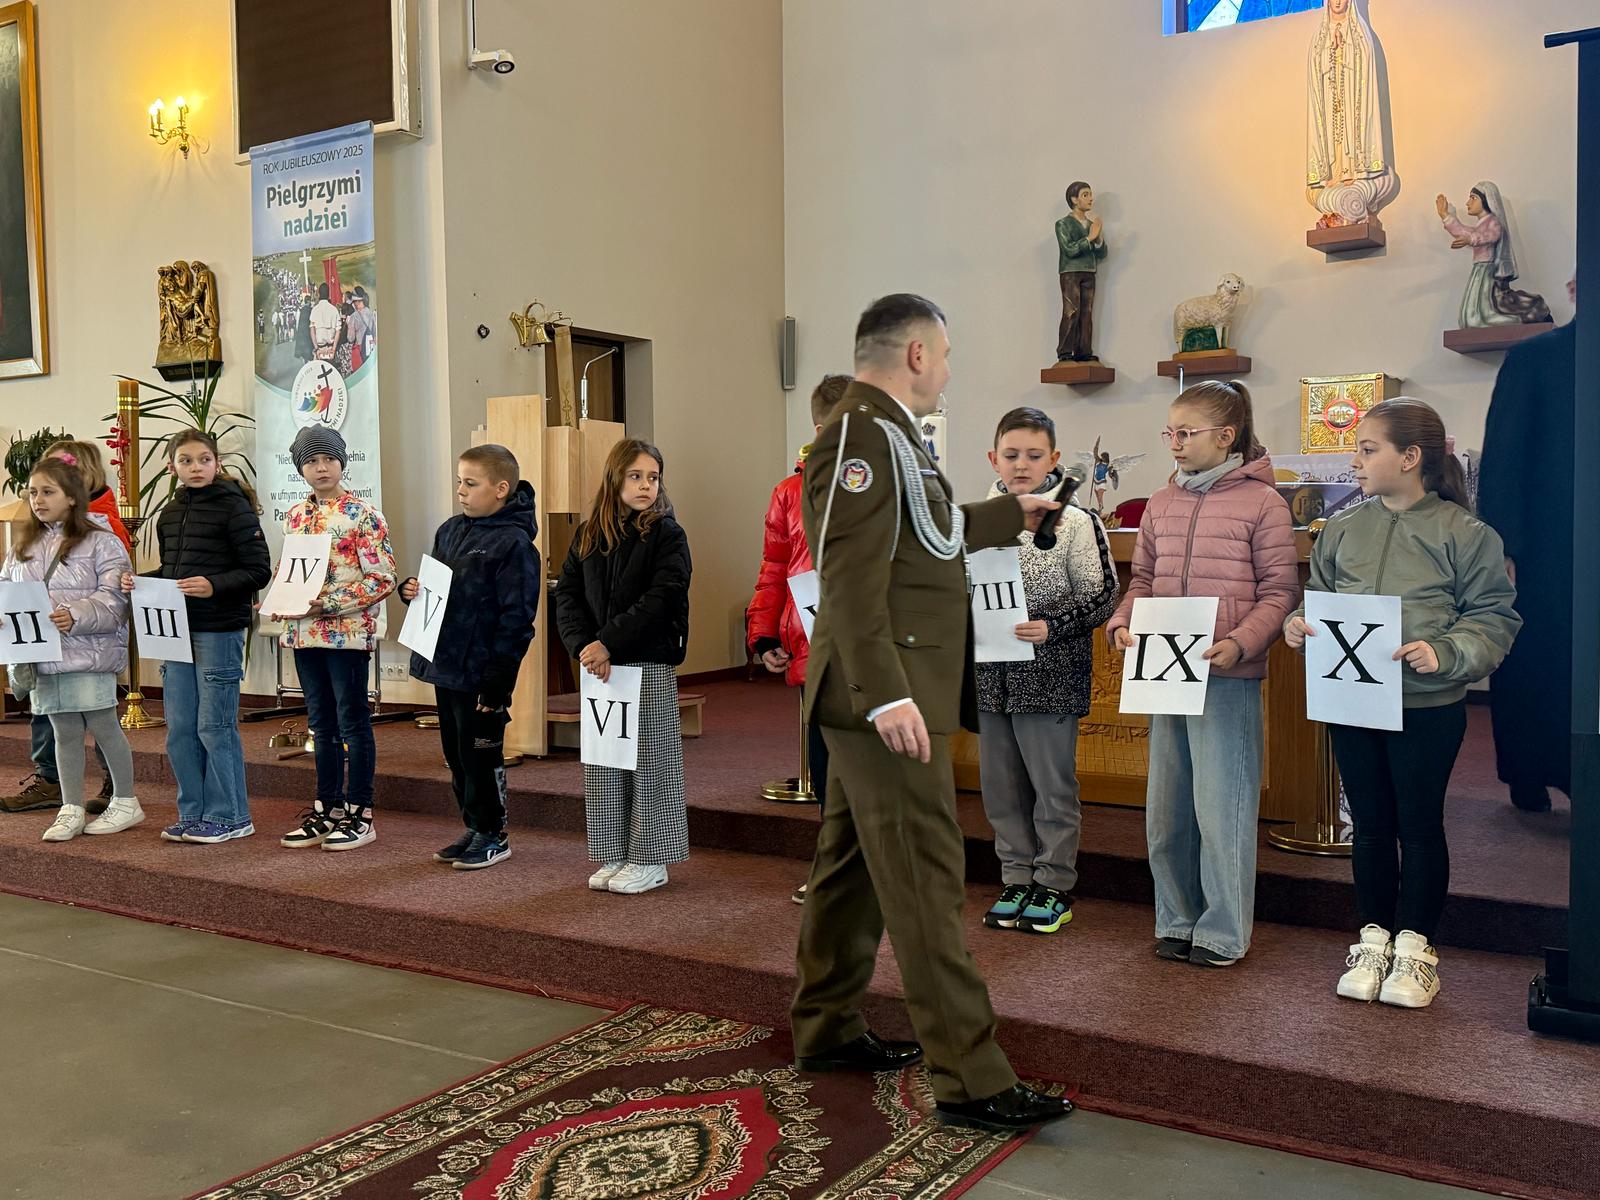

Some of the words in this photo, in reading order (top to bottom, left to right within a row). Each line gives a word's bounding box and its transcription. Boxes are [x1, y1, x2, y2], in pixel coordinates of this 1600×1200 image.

[263, 161, 280, 175] ROK
[280, 148, 342, 172] JUBILEUSZOWY
[343, 144, 364, 159] 2025
[266, 169, 361, 209] Pielgrzymi
[283, 204, 347, 237] nadziei
[271, 492, 277, 500] w
[278, 489, 298, 502] ufnym
[352, 486, 372, 498] owrót
[283, 557, 321, 585] IV
[140, 606, 183, 639] III
[423, 586, 443, 632] V
[4, 610, 48, 645] II
[1128, 633, 1208, 683] IX
[1319, 618, 1385, 685] X
[586, 697, 632, 740] VI
